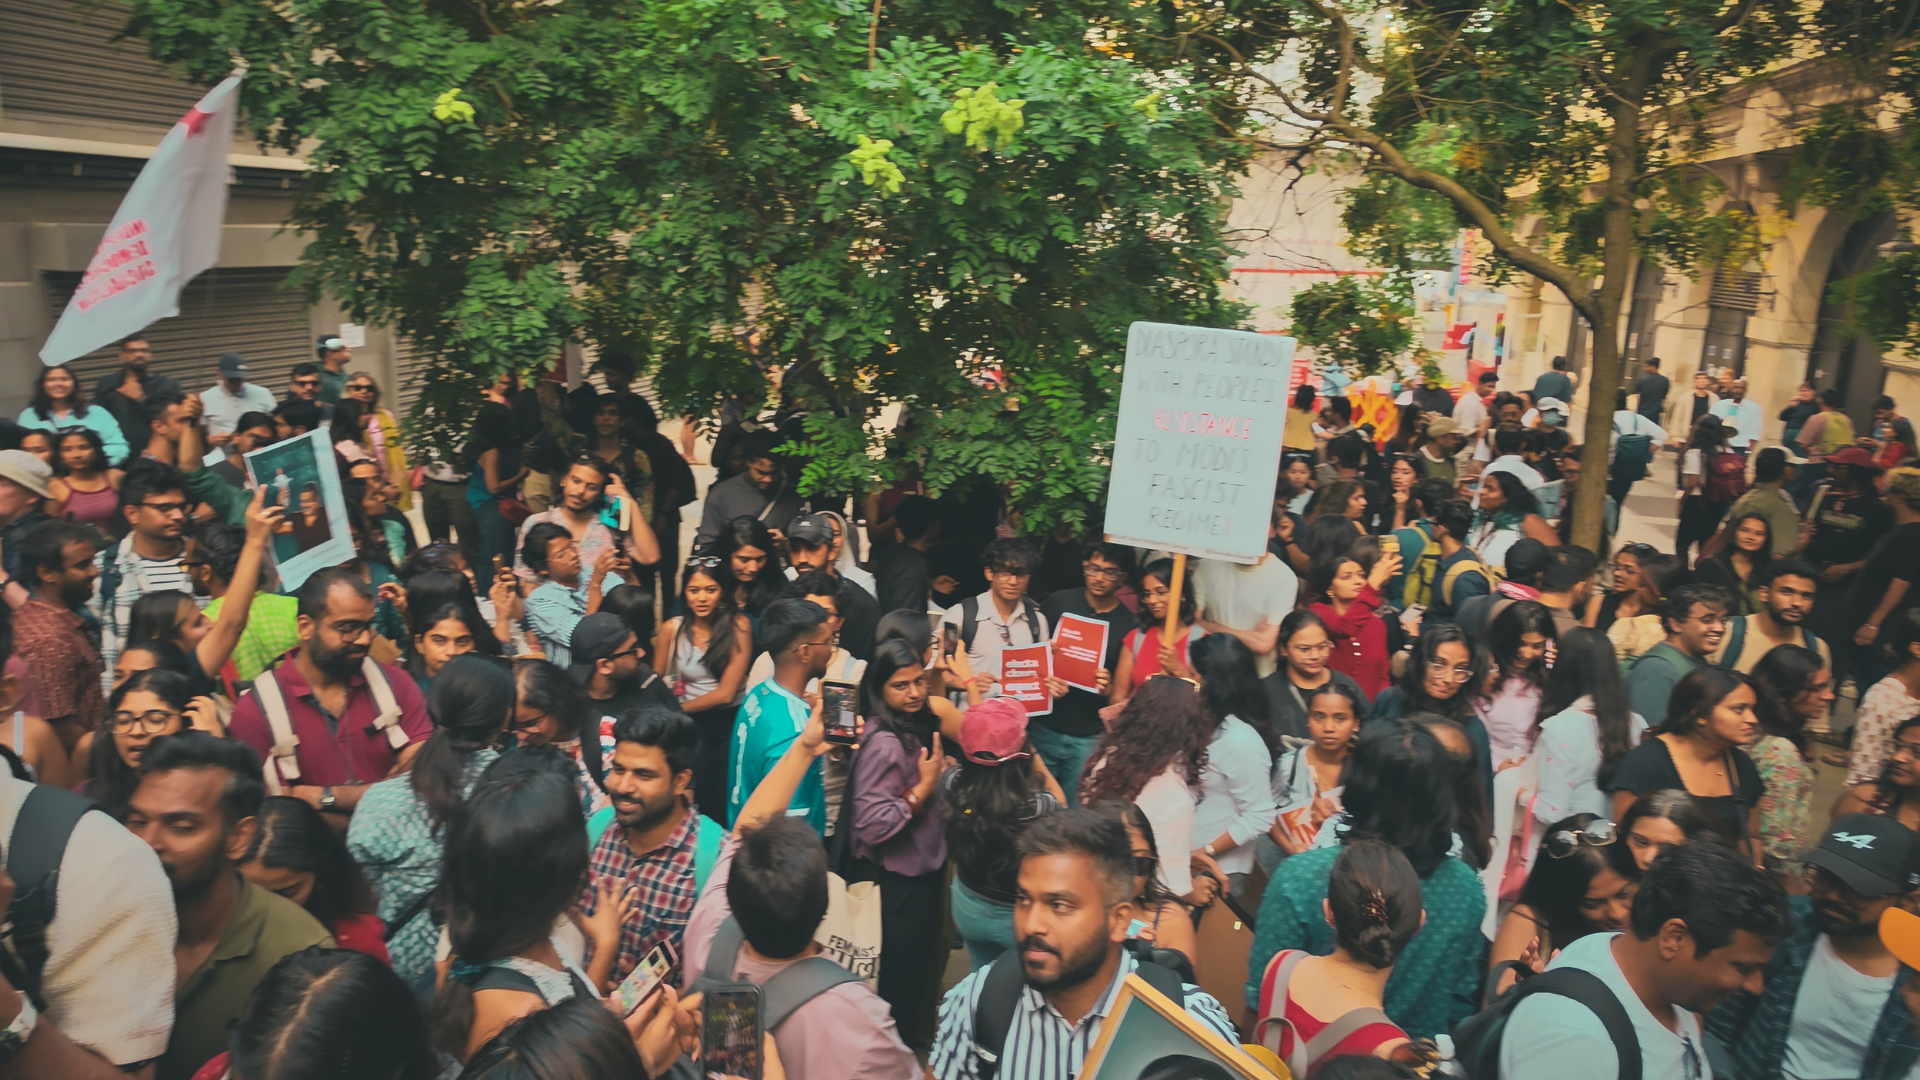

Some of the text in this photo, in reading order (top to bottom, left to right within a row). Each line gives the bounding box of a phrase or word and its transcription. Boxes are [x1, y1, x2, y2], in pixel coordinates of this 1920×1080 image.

[1134, 328, 1287, 369] DIASPORA STANDS
[1136, 369, 1184, 397] WITH
[1153, 407, 1256, 441] RESISTANCE
[1133, 437, 1161, 464] TO
[1147, 472, 1246, 507] FASCIST
